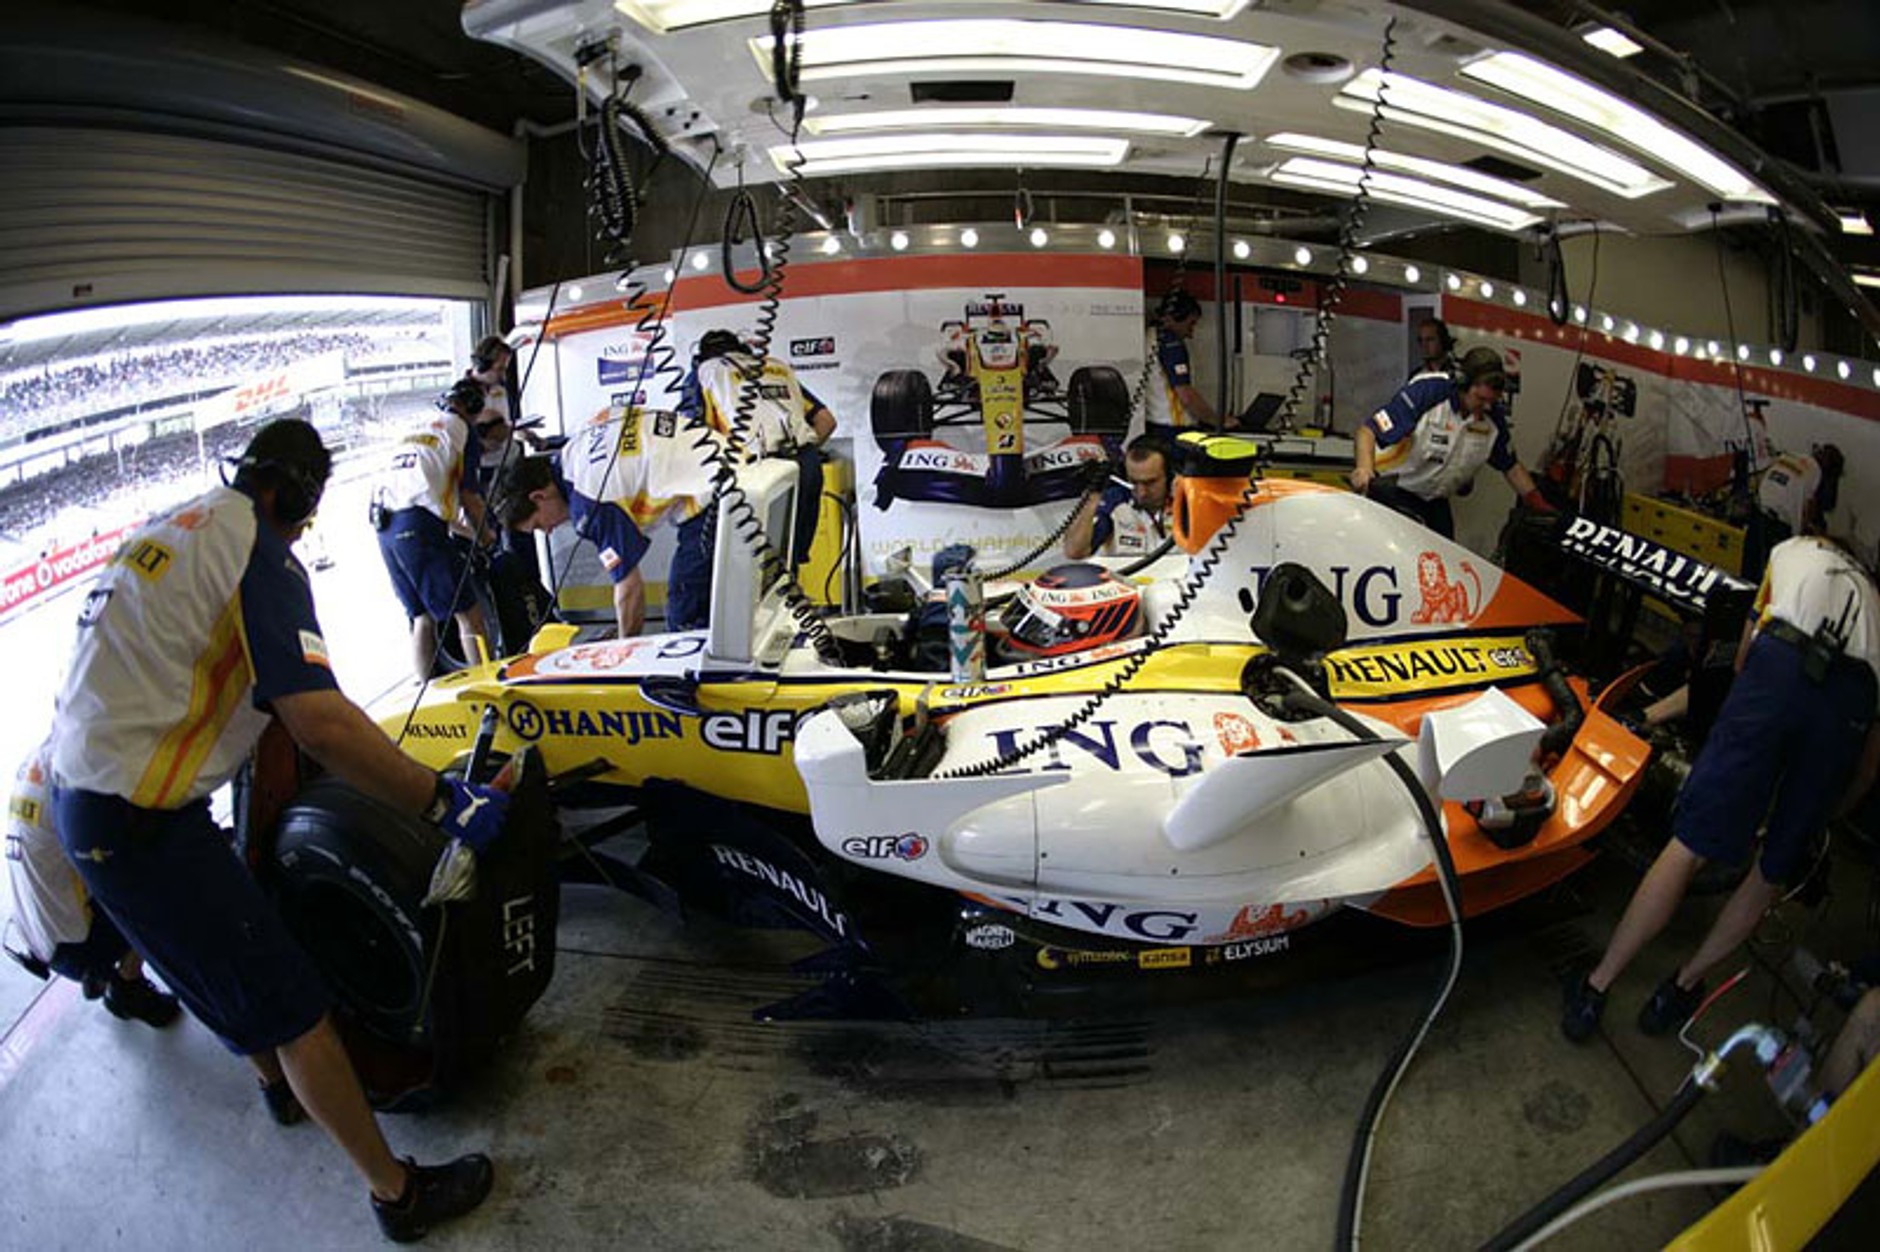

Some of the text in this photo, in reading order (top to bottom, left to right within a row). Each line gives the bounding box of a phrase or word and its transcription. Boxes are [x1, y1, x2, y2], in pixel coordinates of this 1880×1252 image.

[905, 453, 948, 467] ING
[1033, 452, 1073, 468] ING
[1017, 655, 1080, 673] ING
[1331, 648, 1486, 683] RENAULT
[405, 723, 467, 739] RENAULT
[544, 709, 684, 746] HANJIN
[701, 708, 796, 755] elf
[985, 719, 1205, 778] ING
[842, 836, 897, 858] elf
[711, 844, 848, 936] RENAULT
[503, 896, 534, 975] LEFT
[1223, 936, 1290, 960] ELYSIUM
